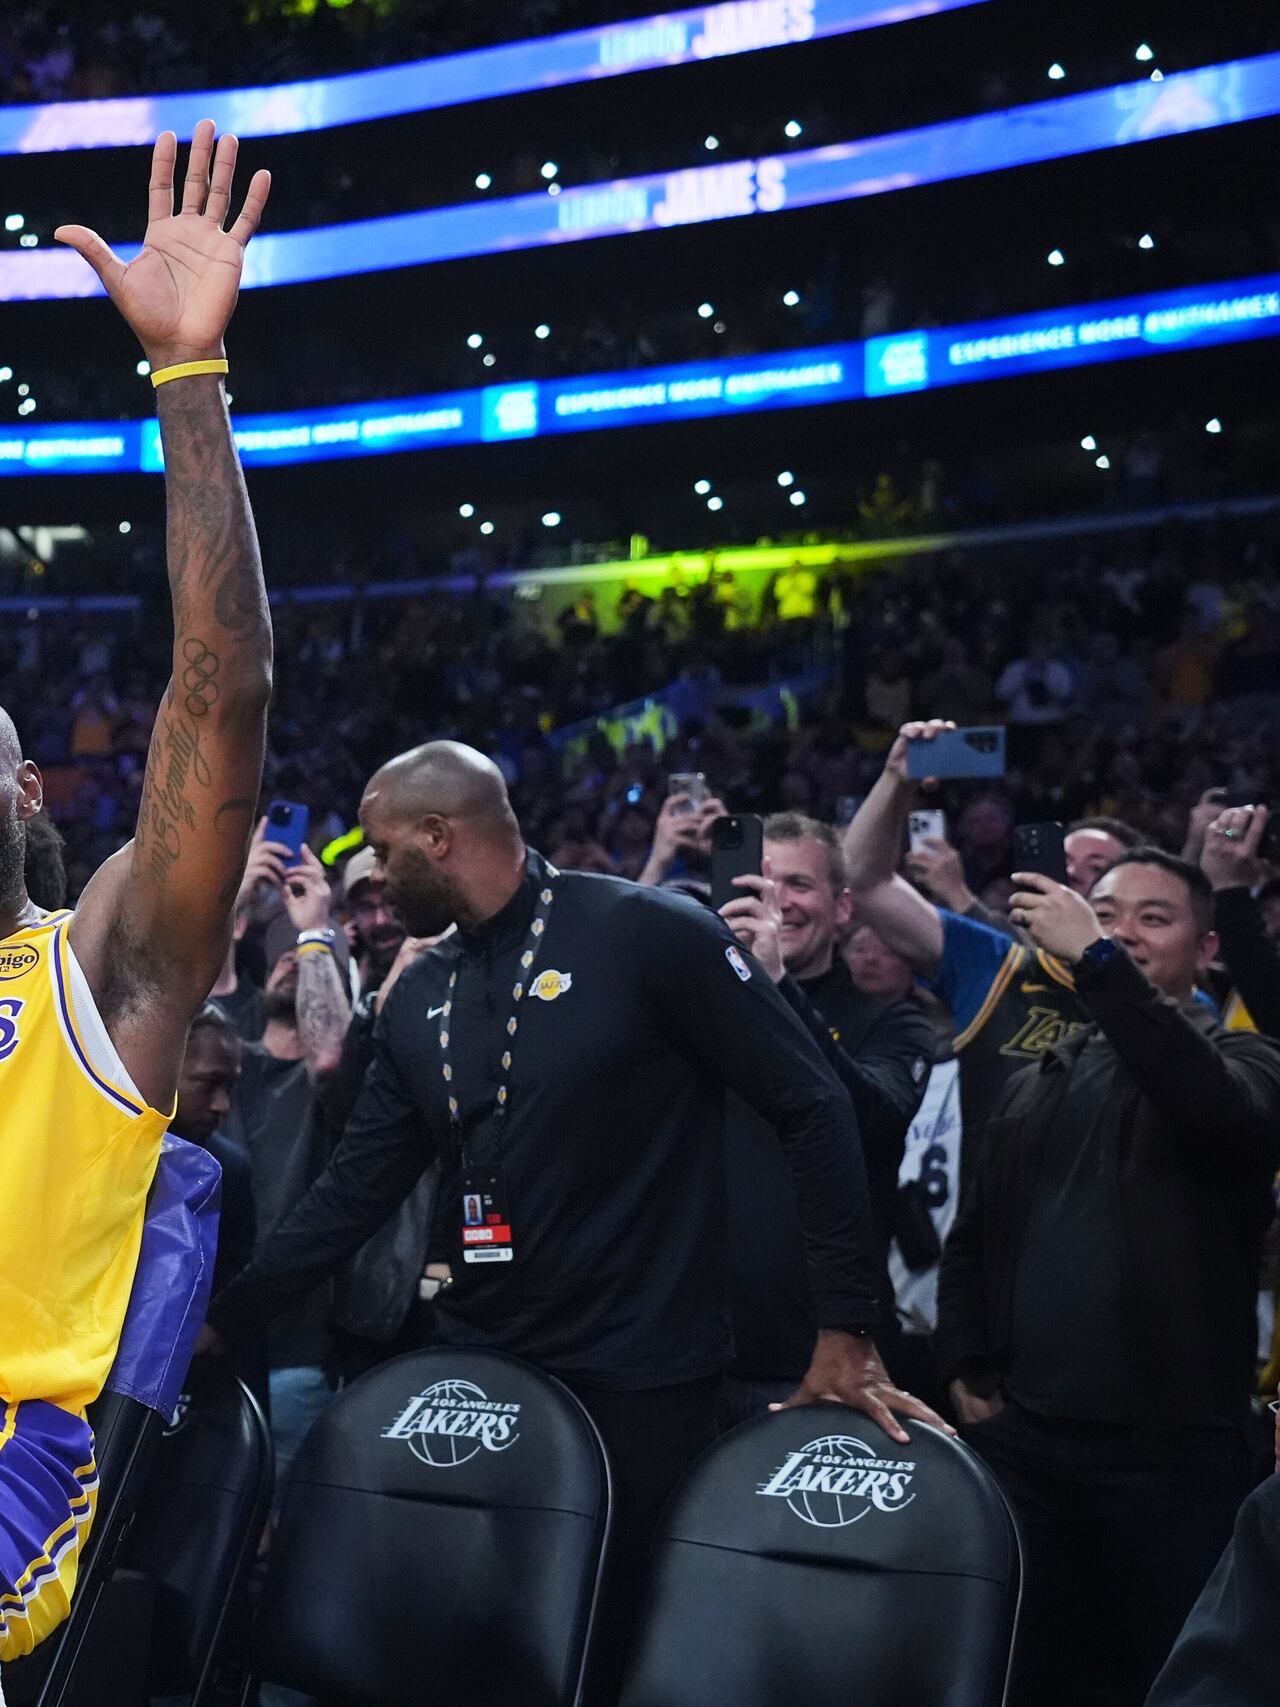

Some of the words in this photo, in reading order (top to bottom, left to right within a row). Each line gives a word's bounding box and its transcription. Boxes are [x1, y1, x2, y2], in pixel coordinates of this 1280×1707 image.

[652, 158, 786, 227] JAMES
[949, 324, 1076, 365] EXPERIENCE
[1078, 313, 1141, 345] MORE
[555, 383, 666, 416] EXPERIENCE
[668, 376, 723, 402] MORE
[380, 1396, 521, 1451] LAKERS
[430, 1397, 457, 1408] LOS
[459, 1399, 521, 1412] ANGELES
[755, 1451, 917, 1512] LAKERS
[812, 1454, 841, 1464] LOS
[842, 1456, 917, 1472] ANGELES
